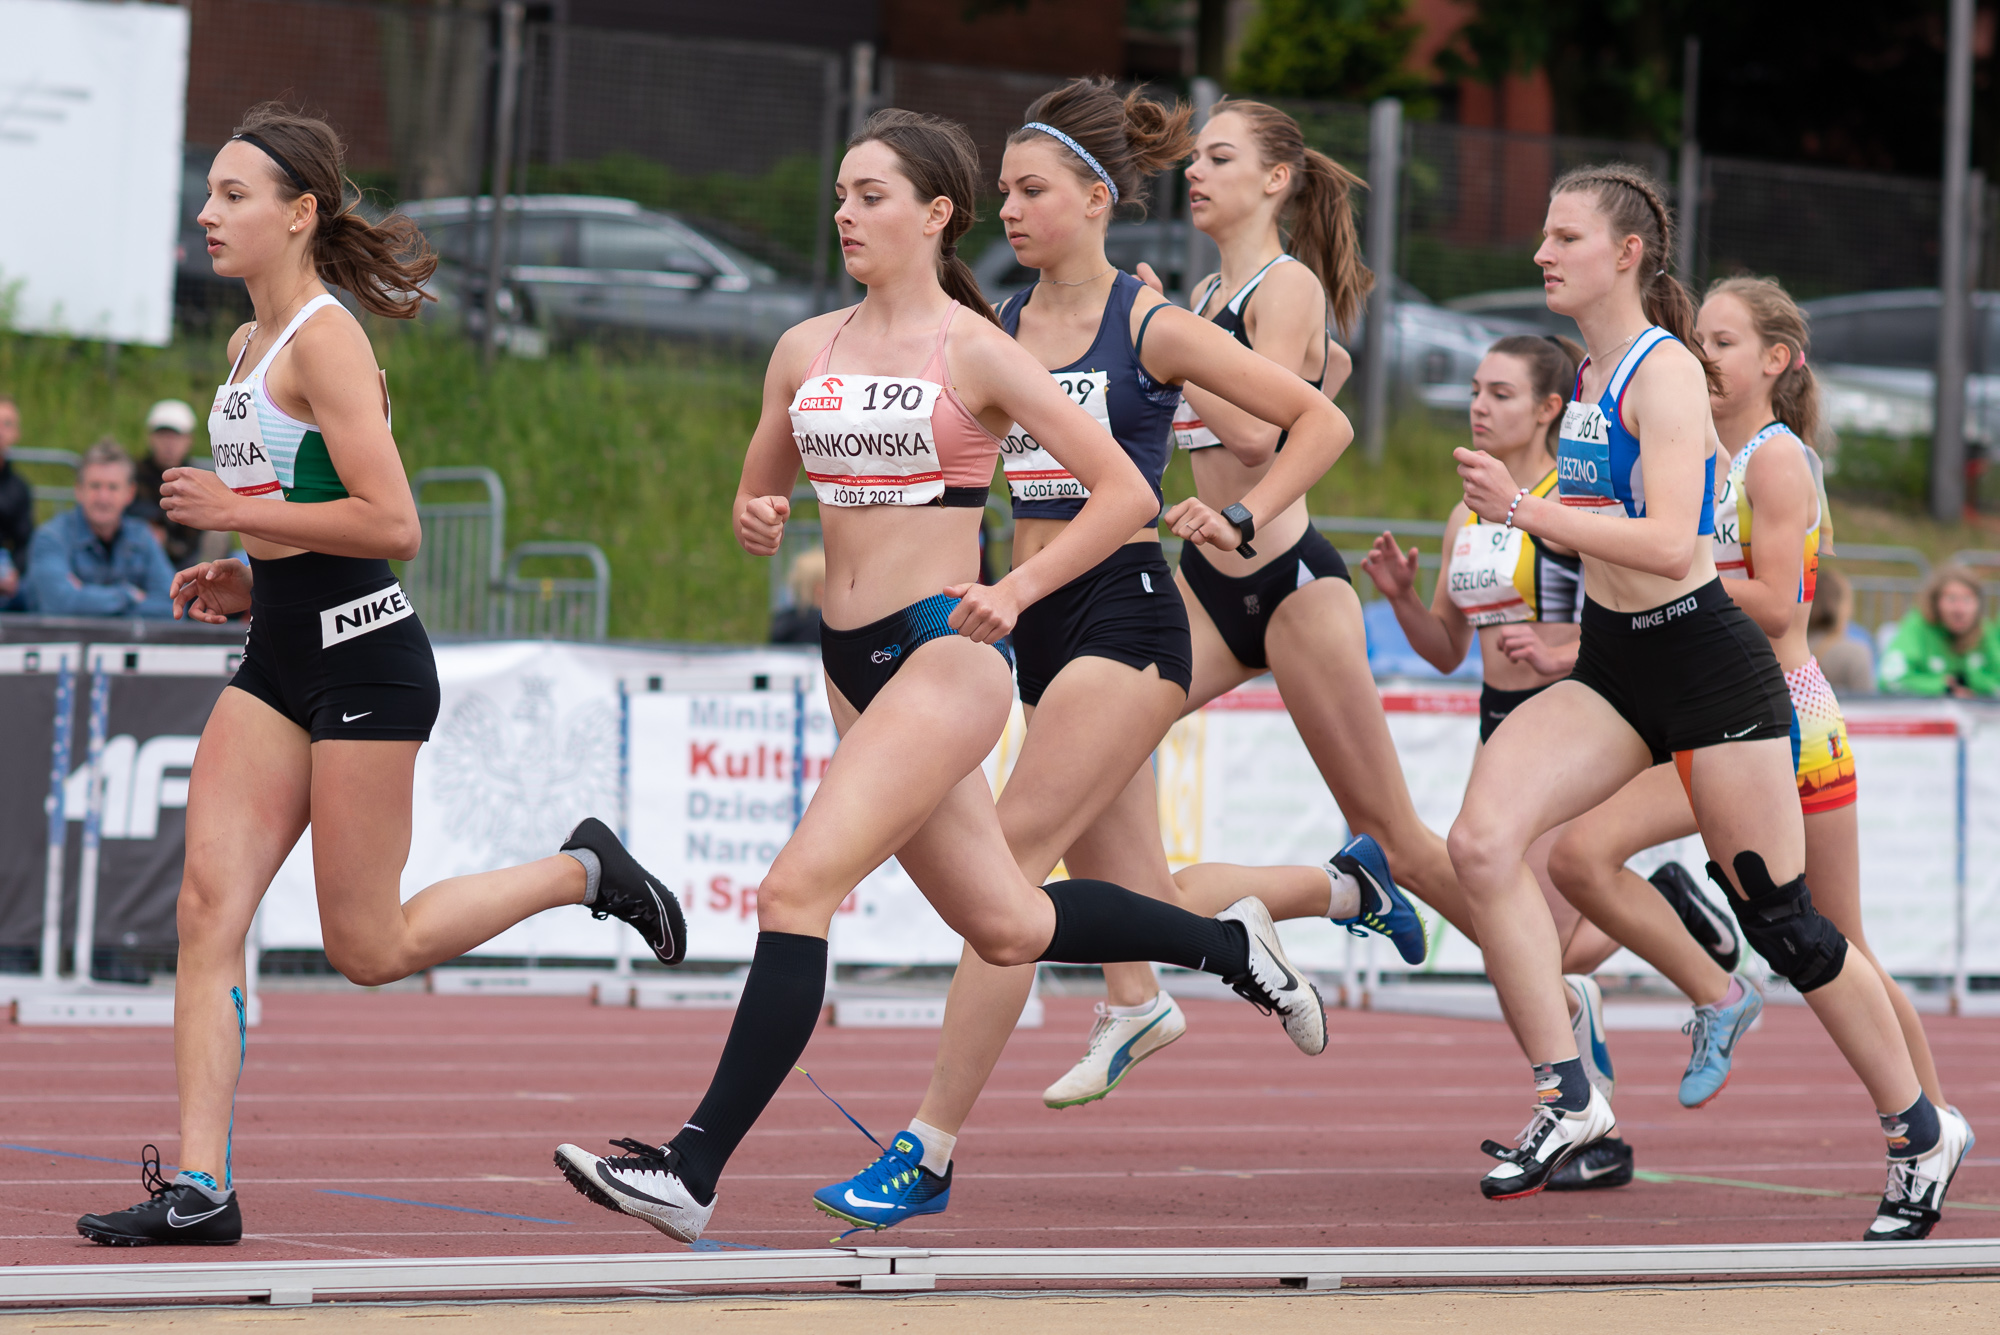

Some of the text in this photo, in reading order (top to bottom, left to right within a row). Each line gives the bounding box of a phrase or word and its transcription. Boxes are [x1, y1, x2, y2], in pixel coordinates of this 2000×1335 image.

[800, 398, 841, 410] ORLEN
[862, 382, 923, 411] 190
[834, 486, 903, 505] ŁÓDŹ 2021
[1023, 480, 1085, 497] ŁÓDŹ 2021
[1451, 568, 1498, 592] SZELIGA
[335, 591, 406, 634] NIKE
[1632, 596, 1698, 630] NIKE PRO
